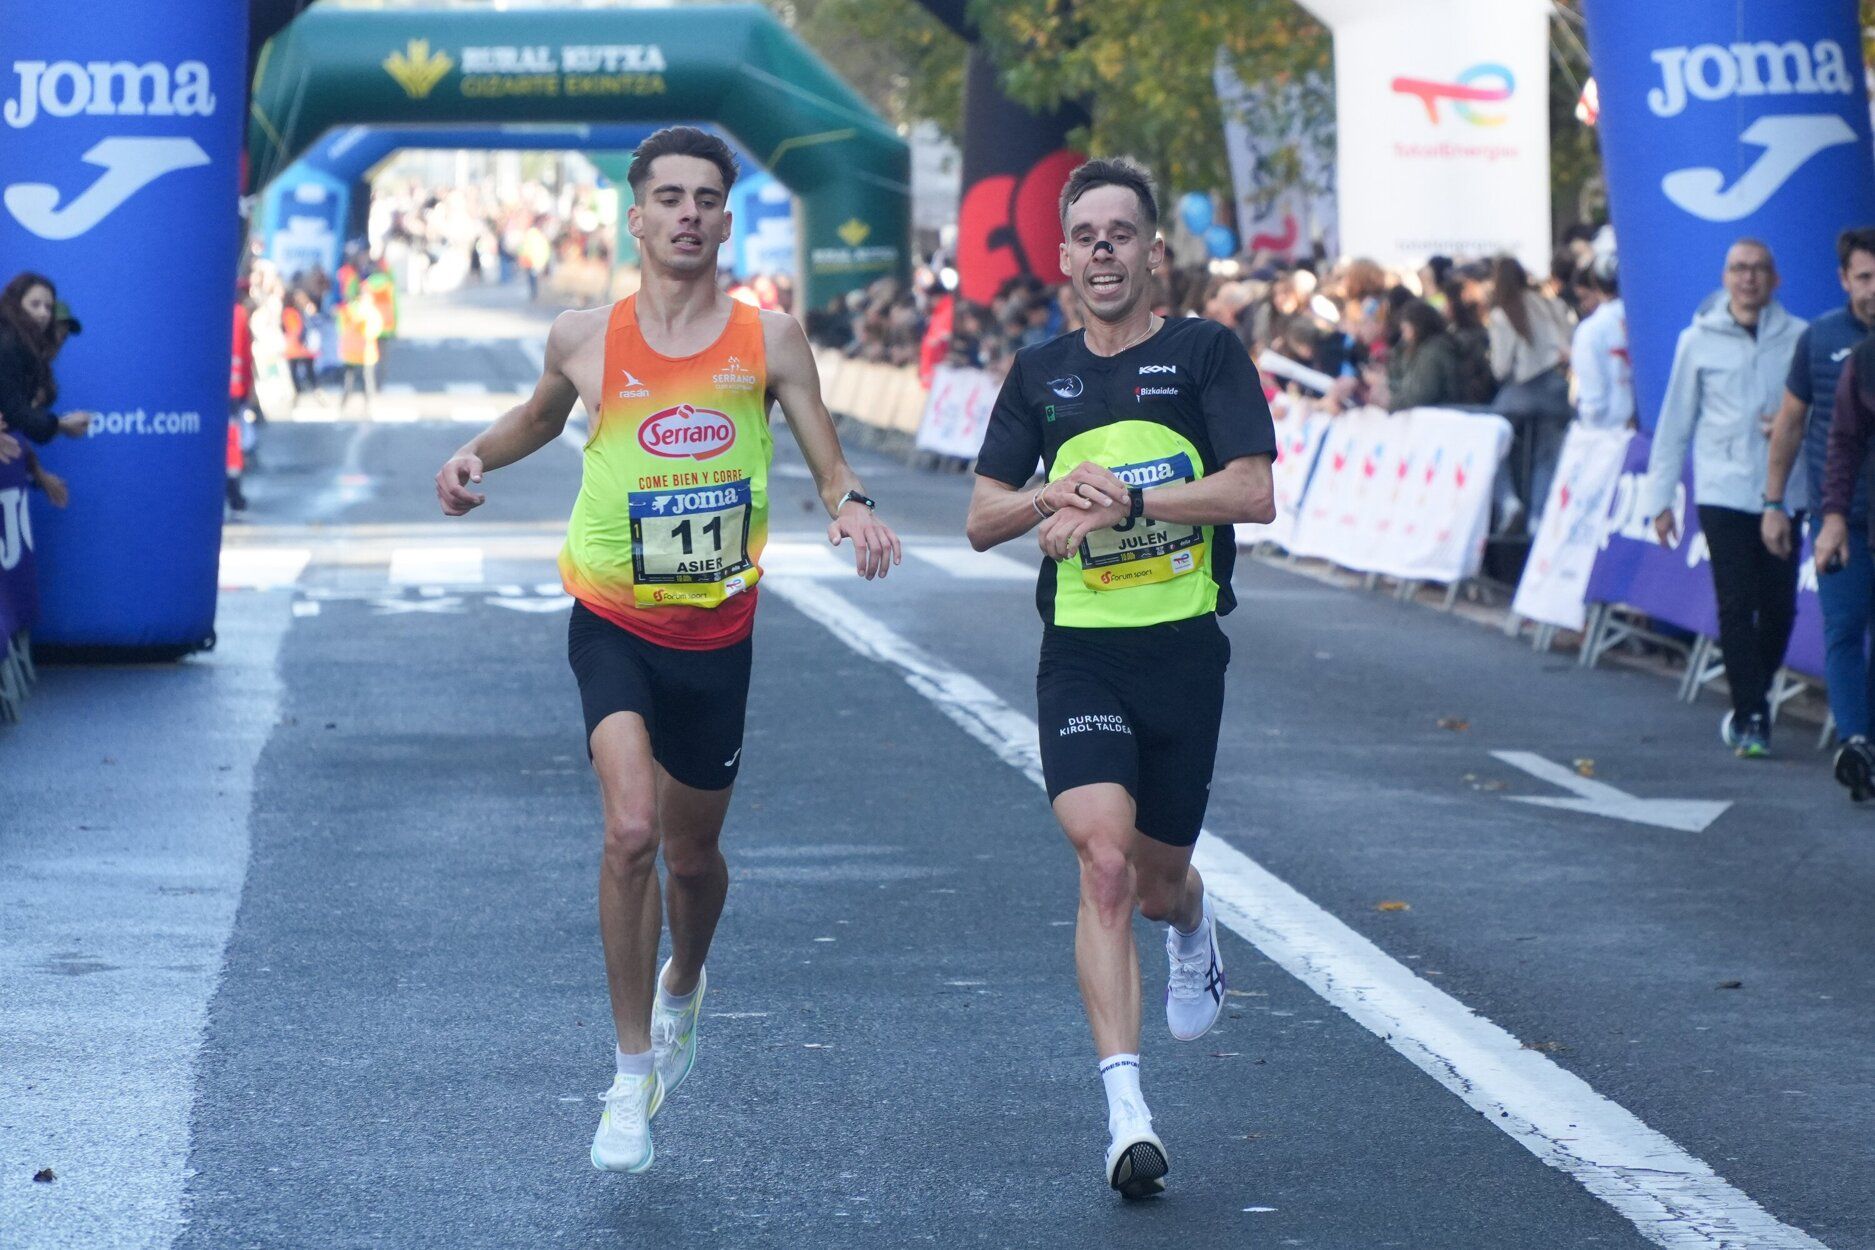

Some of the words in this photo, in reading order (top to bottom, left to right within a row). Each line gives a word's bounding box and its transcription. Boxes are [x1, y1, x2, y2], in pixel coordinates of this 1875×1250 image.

[460, 45, 558, 75] RURAL
[560, 43, 668, 74] KUTXA
[1647, 39, 1853, 118] Joma
[3, 60, 216, 128] Joma
[711, 373, 756, 385] SERRANO
[1140, 386, 1179, 396] Bizkaialde
[646, 421, 730, 447] Serrano
[638, 474, 668, 490] COME
[672, 472, 698, 487] BIEN
[702, 471, 709, 485] Y
[713, 469, 743, 484] CORRE
[1113, 462, 1175, 487] oma
[671, 487, 739, 515] Joma
[671, 515, 722, 555] 11
[1118, 530, 1168, 551] JULEN
[676, 557, 723, 573] ASIER
[1060, 724, 1093, 735] KIROL
[1096, 723, 1131, 735] TALDEA
[1069, 715, 1122, 725] DURANGO
